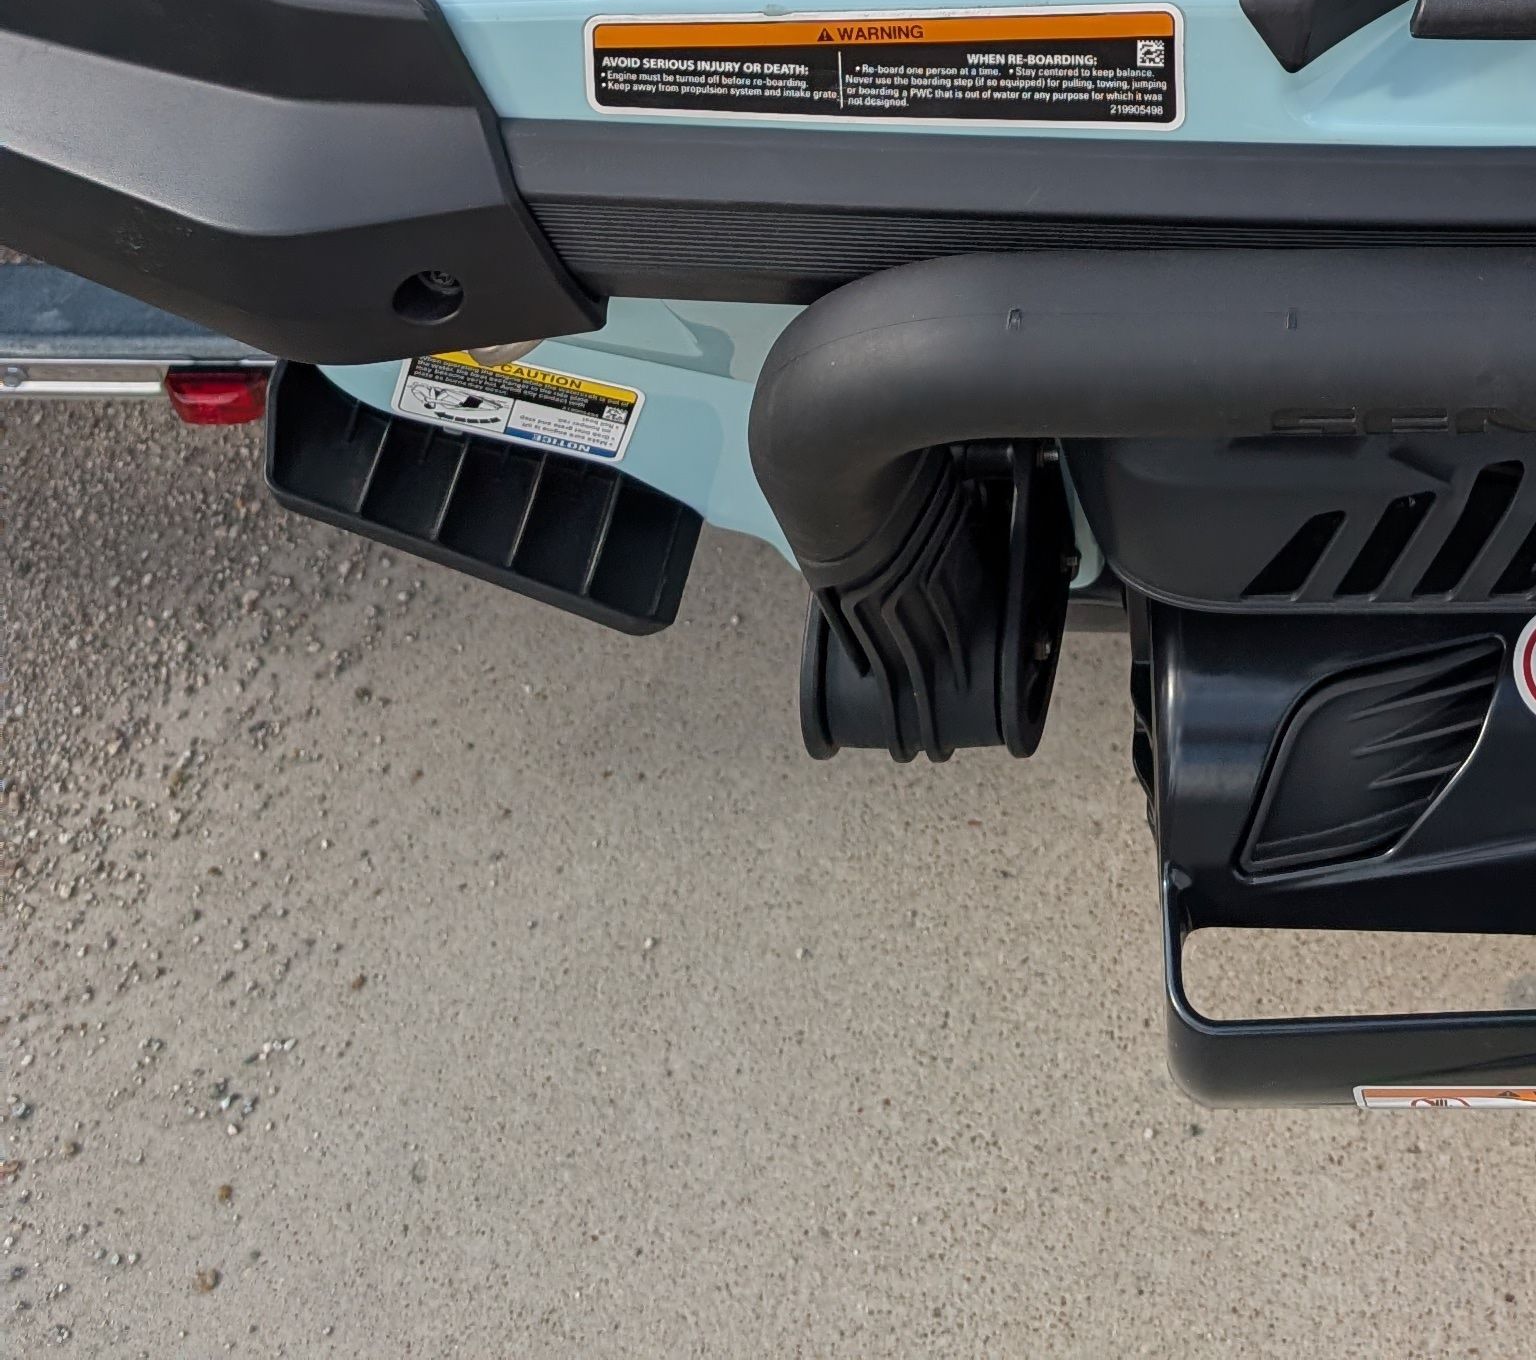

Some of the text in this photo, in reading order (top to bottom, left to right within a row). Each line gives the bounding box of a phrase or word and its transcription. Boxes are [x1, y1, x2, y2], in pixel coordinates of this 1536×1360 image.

[837, 24, 925, 41] WARNING
[602, 56, 809, 77] AVOID SERIOUS INJURY OR DEATH:
[967, 54, 1098, 67] WHEN RE-BOARDING:
[862, 63, 904, 75] Re-board
[906, 66, 924, 75] one
[926, 67, 958, 78] person
[1015, 66, 1037, 78] Stay
[1081, 68, 1091, 77] to
[1092, 68, 1115, 79] keep
[1116, 67, 1156, 78] balance.
[607, 70, 809, 90] Engine must be turned off before re-boarding.
[845, 74, 873, 84] Never
[875, 77, 892, 85] use
[894, 76, 909, 86] the
[911, 76, 951, 89] boarding
[953, 78, 974, 89] step
[999, 78, 1046, 90] equipped)
[1047, 79, 1061, 88] for
[1062, 79, 1095, 90] pulling,
[1097, 80, 1130, 91] towing,
[1131, 80, 1167, 92] jumping
[608, 81, 840, 101] Keep away from propulsion system and intake grate.
[846, 87, 856, 95] or
[858, 86, 899, 98] boarding
[910, 88, 934, 98] PWC
[935, 89, 953, 99] that
[955, 89, 963, 99] is
[965, 90, 980, 99] out
[982, 89, 992, 99] of
[993, 90, 1020, 100] water
[1021, 91, 1032, 100] or
[1033, 92, 1051, 103] any
[1052, 92, 1090, 103] purpose
[1091, 91, 1105, 101] for
[1106, 90, 1134, 101] which
[1136, 91, 1143, 101] it
[1144, 92, 1163, 101] was
[848, 96, 910, 109] not designed.
[500, 363, 583, 389] CAUTION
[531, 432, 590, 452] NOTICE
